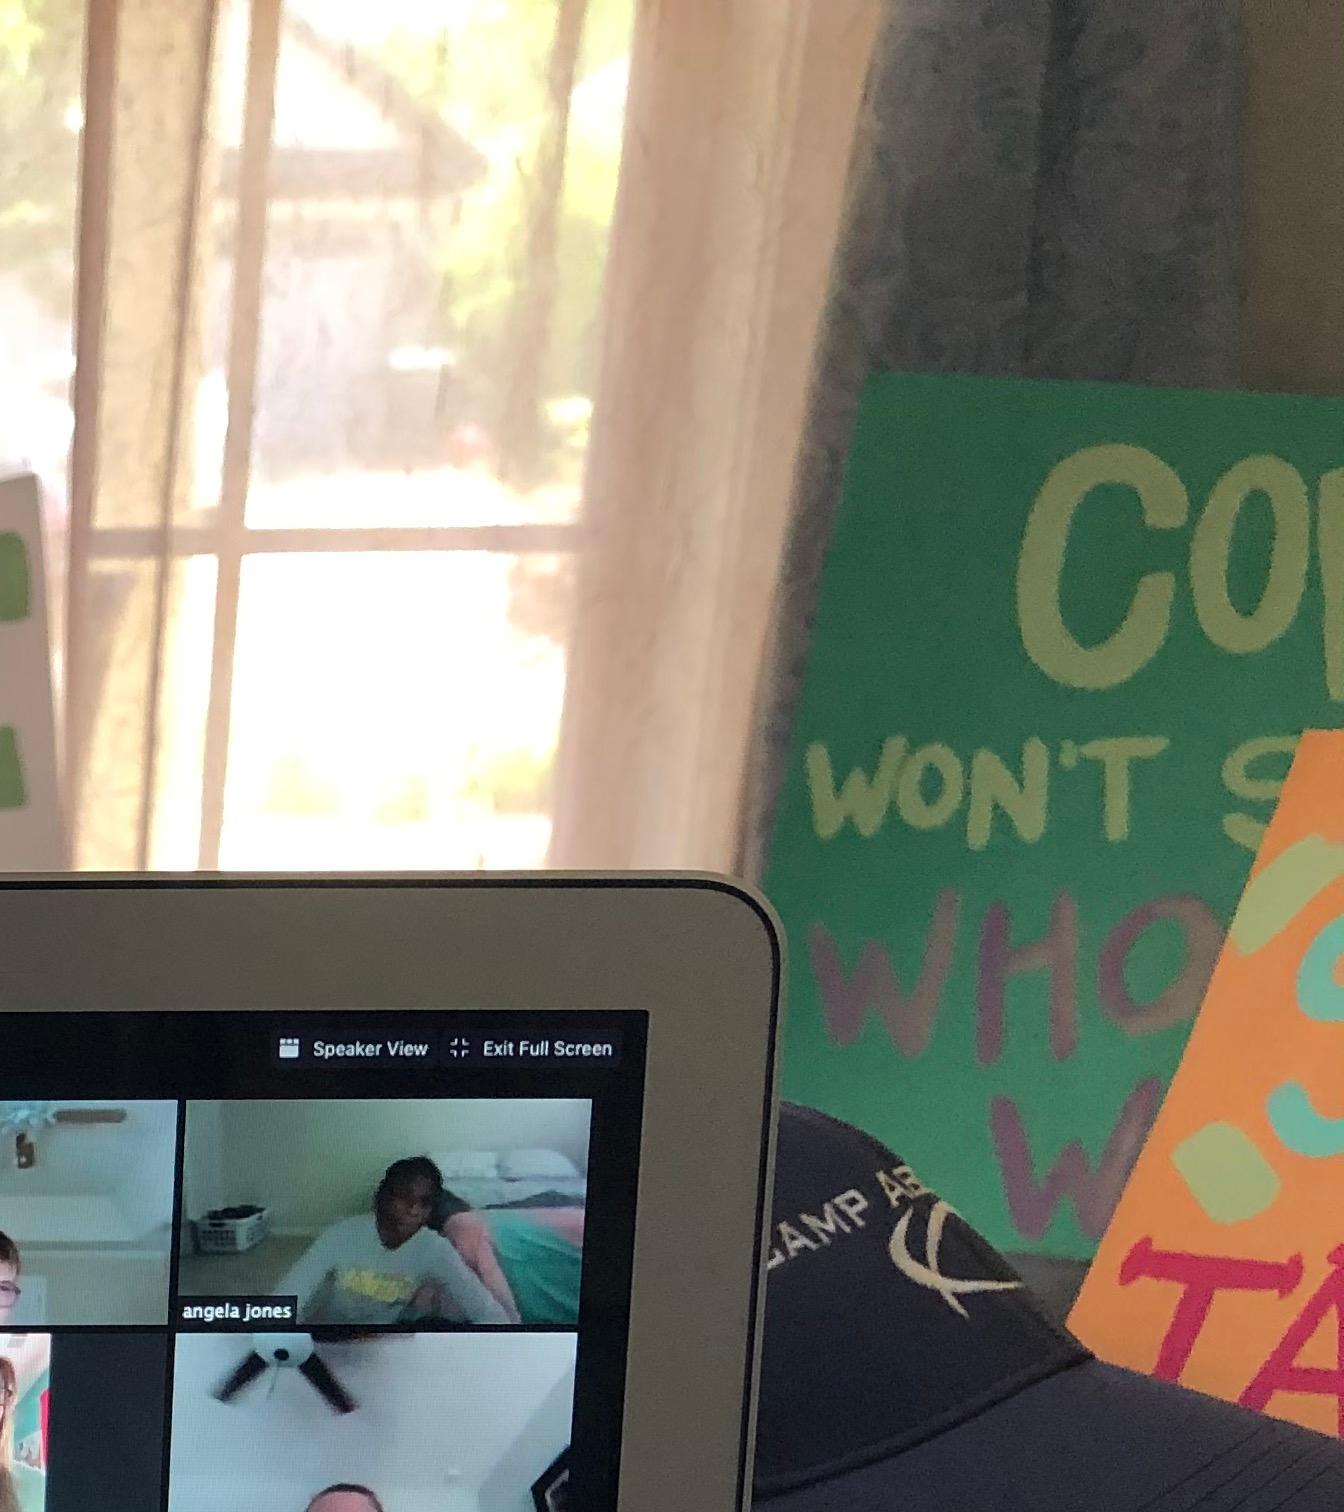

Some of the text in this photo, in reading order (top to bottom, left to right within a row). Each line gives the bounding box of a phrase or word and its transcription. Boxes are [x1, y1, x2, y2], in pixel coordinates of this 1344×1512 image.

[805, 736, 1172, 852] WON'T
[807, 887, 1225, 1066] WHO
[313, 1040, 429, 1060] Speaker View
[483, 1040, 613, 1057] Exit Full Screen
[767, 1188, 869, 1270] AMP
[181, 1302, 292, 1322] angela jones
